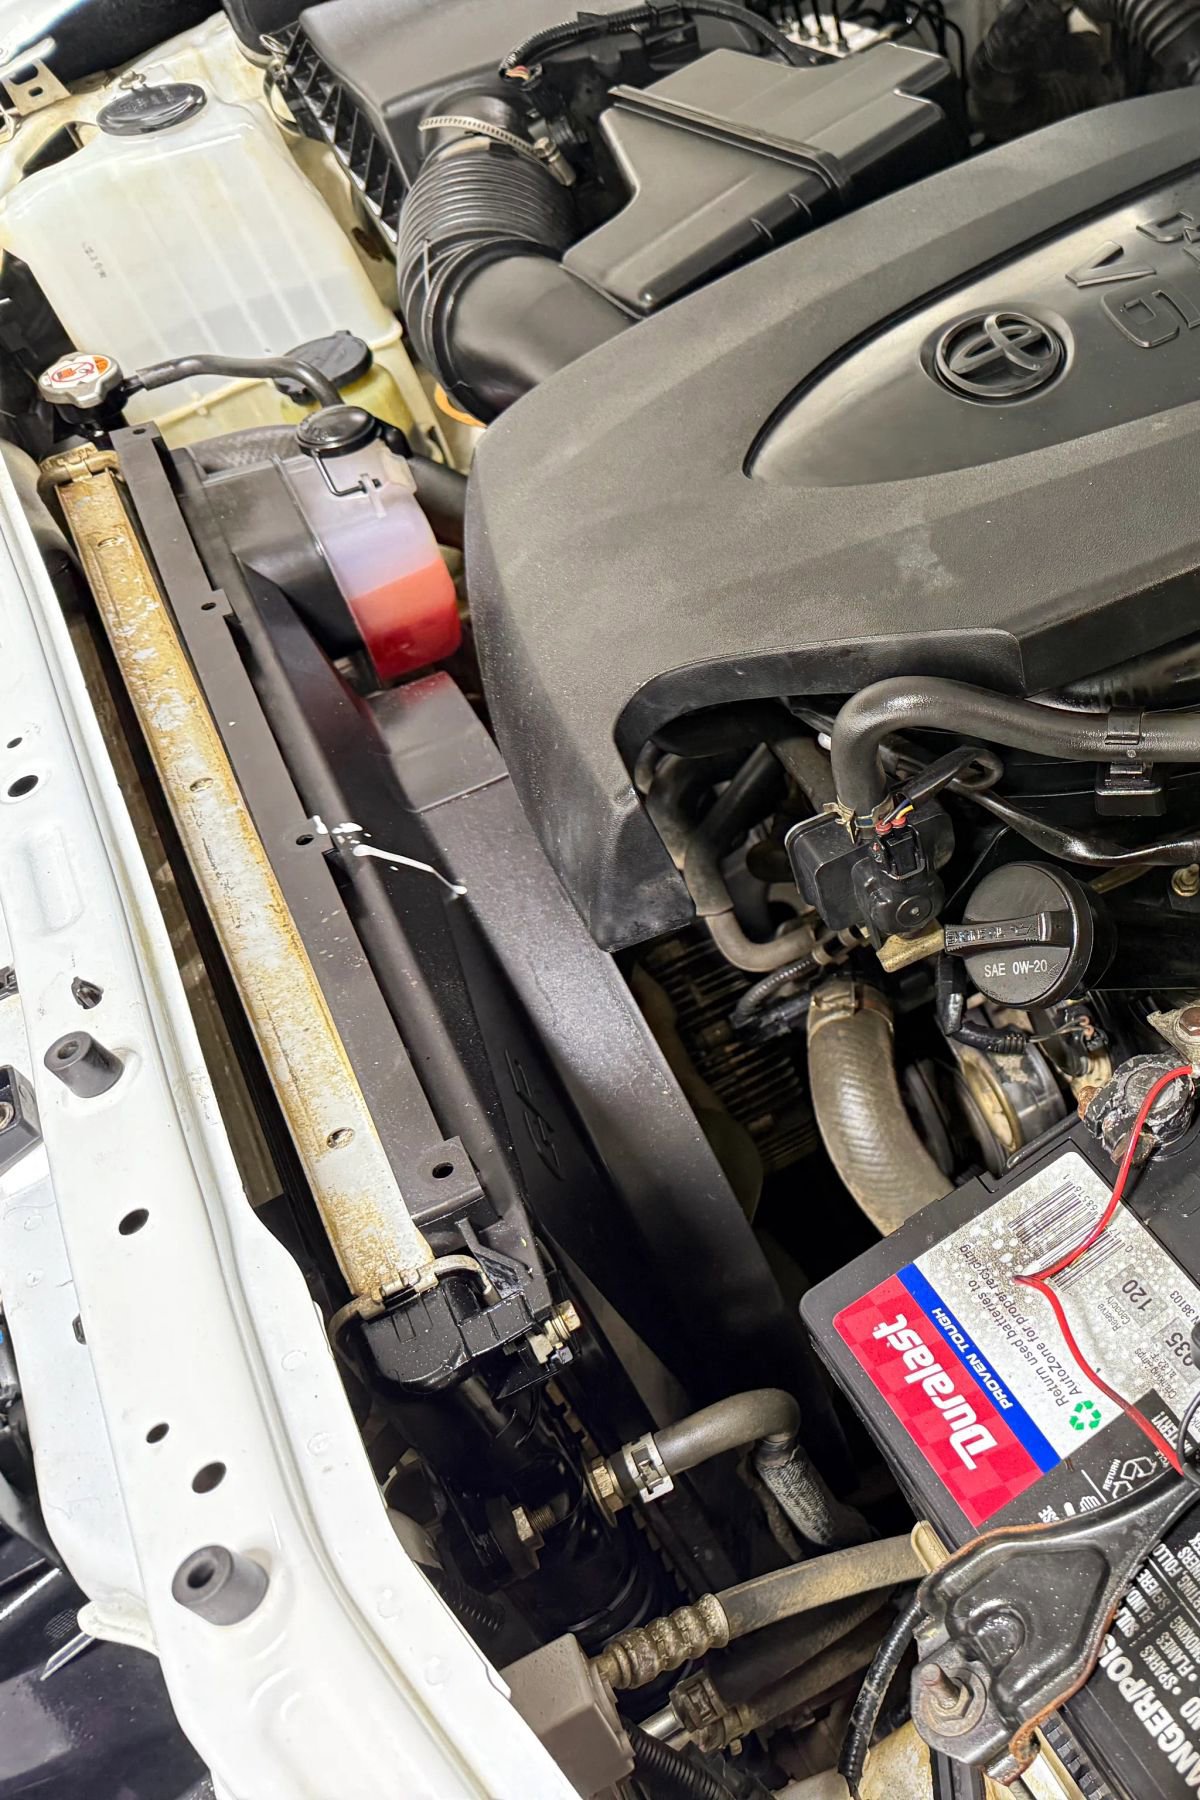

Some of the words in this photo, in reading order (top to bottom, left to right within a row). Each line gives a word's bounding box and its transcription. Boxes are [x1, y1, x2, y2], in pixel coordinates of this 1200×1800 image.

[984, 963, 1006, 977] SAE
[1012, 959, 1048, 975] 0W-20
[959, 1243, 998, 1289] recycling
[967, 1279, 980, 1291] to
[1120, 1276, 1154, 1312] 120
[1169, 1289, 1195, 1317] 38103
[976, 1291, 1017, 1338] batteries
[994, 1289, 1028, 1324] proper
[1095, 1302, 1121, 1331] Reserve
[1104, 1294, 1131, 1325] Capacity
[931, 1306, 970, 1352] TOUGH
[1022, 1324, 1039, 1341] for
[1010, 1338, 1038, 1366] used
[1035, 1341, 1082, 1394] AutoZone
[1133, 1347, 1153, 1369] Amps
[871, 1312, 997, 1468] Duralast
[965, 1352, 1013, 1408] PROVEN
[1034, 1366, 1069, 1406] Return
[1148, 1366, 1177, 1399] Cranking
[1102, 1458, 1120, 1490] RETURN
[1151, 1540, 1183, 1577] FOLLO
[1135, 1567, 1171, 1610] SEVERE
[1138, 1643, 1179, 1690] SPARKS
[1154, 1630, 1194, 1676] FLAMES
